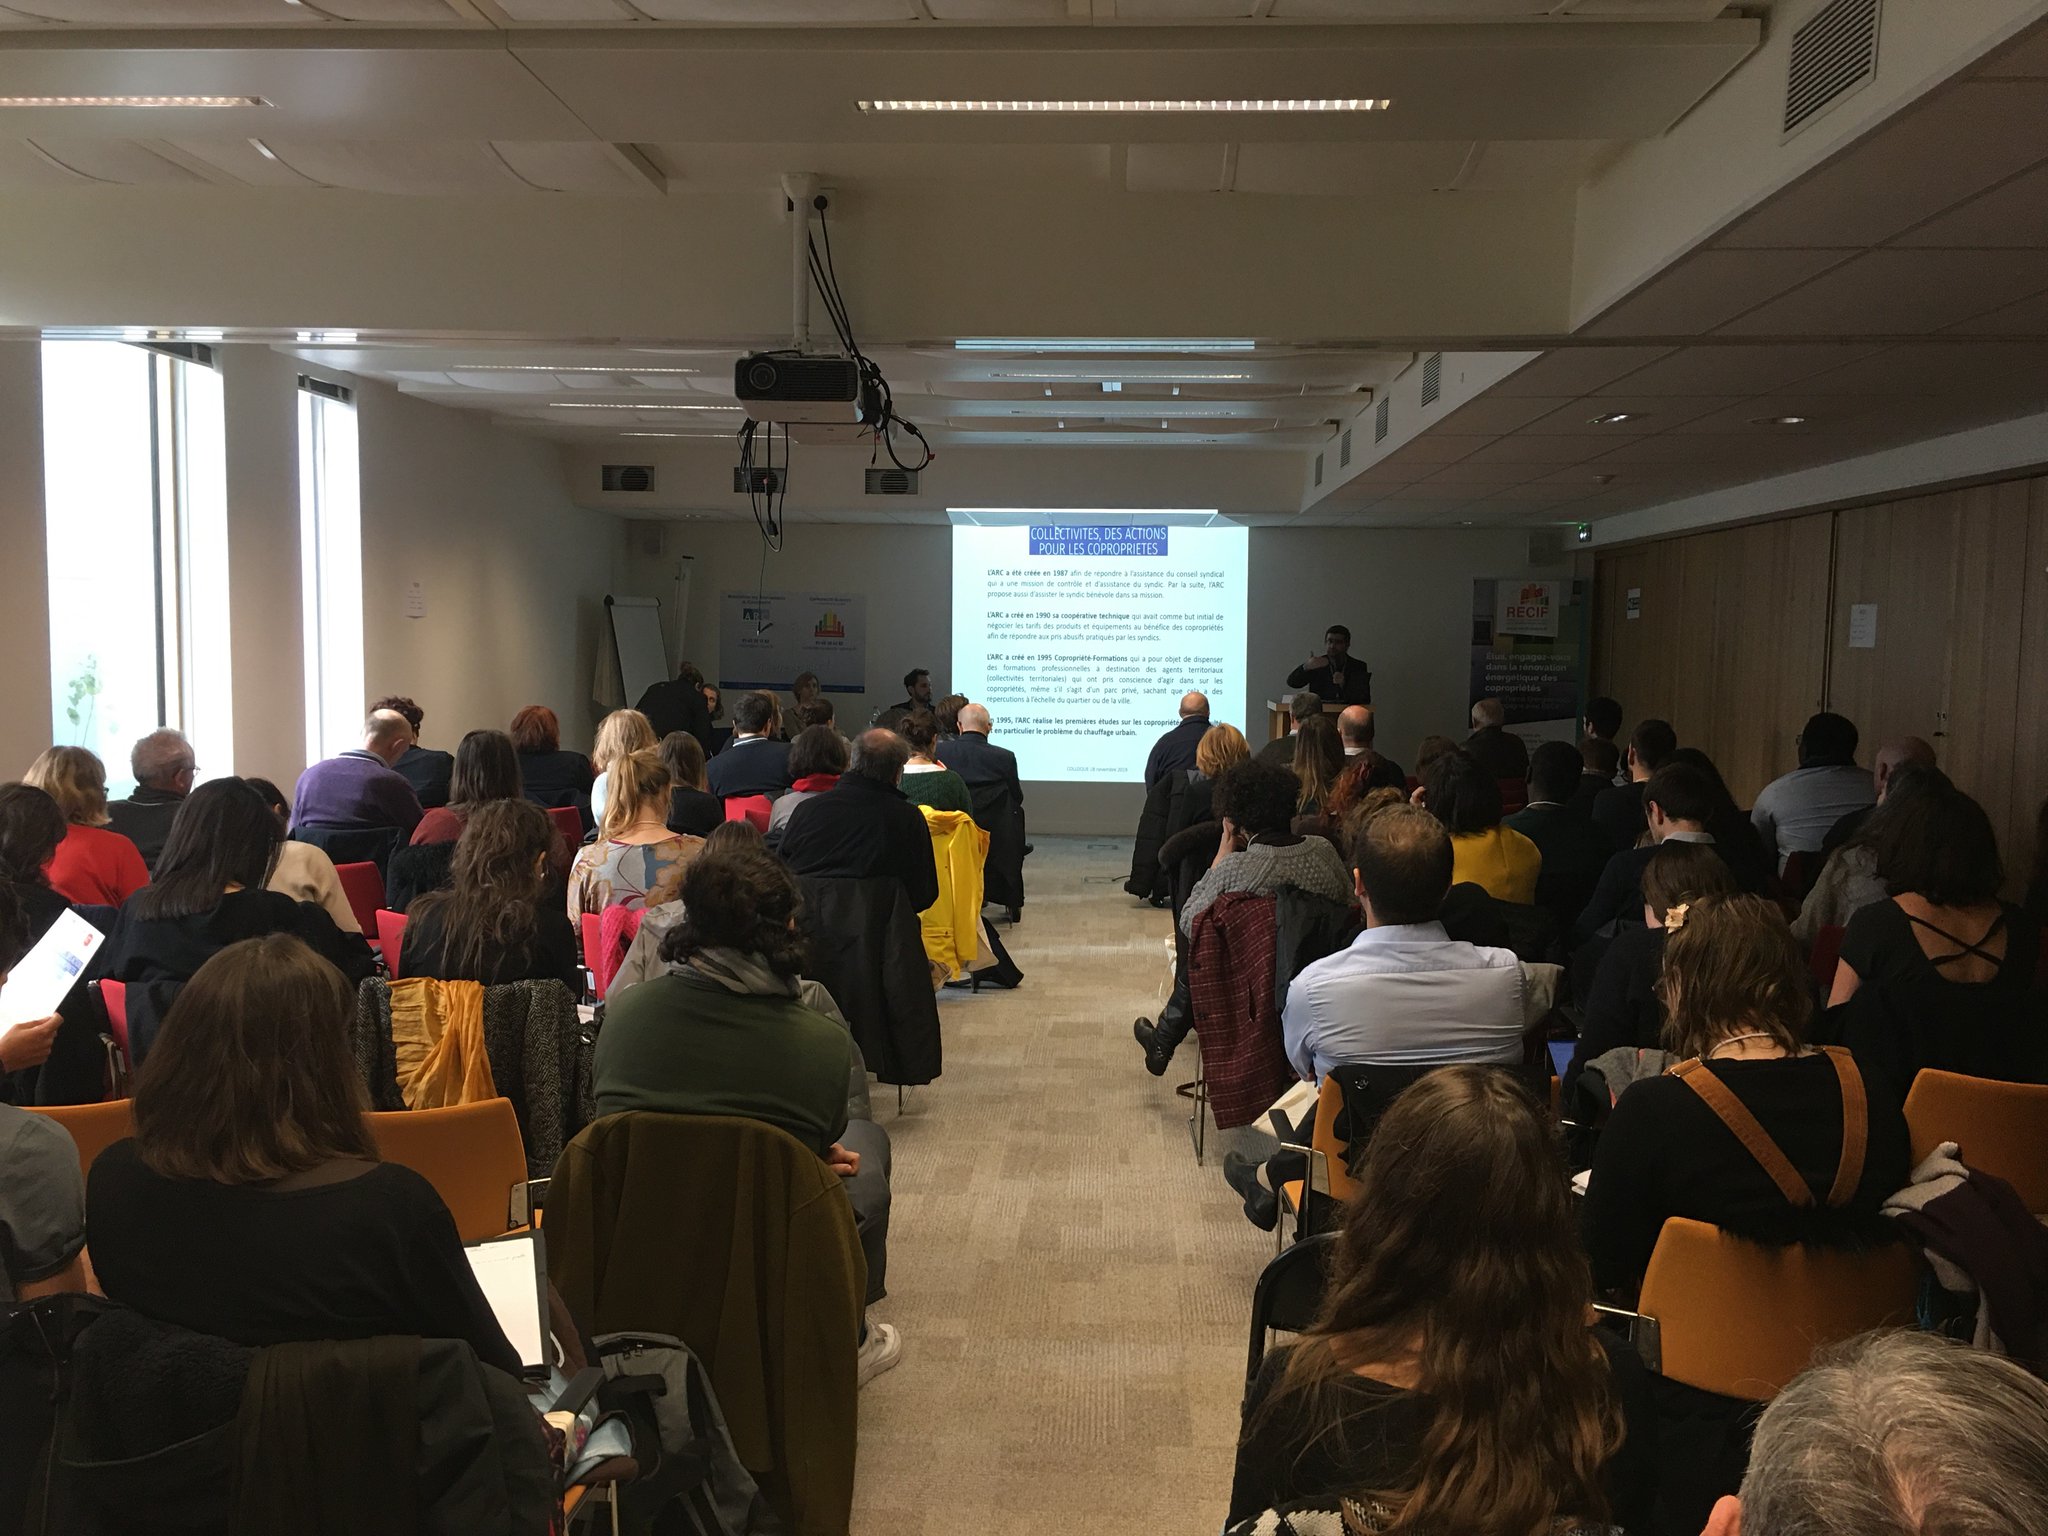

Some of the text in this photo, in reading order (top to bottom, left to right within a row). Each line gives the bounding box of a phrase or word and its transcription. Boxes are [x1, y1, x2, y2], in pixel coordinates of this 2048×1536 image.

[1031, 527, 1166, 542] COLLECTIVITES, DES ACTIONS
[1039, 542, 1159, 555] POUR LES COPROPRIETES
[1094, 569, 1122, 579] répondre
[1200, 569, 1225, 580] syndical
[987, 579, 998, 589] qui
[987, 592, 1013, 600] propose
[1066, 590, 1085, 600] syndic
[1060, 611, 1098, 621] coopérative
[1098, 611, 1130, 621] technique
[1131, 612, 1142, 622] qui
[987, 621, 1014, 631] négocier
[1056, 622, 1082, 632] produits
[1091, 622, 1132, 632] équipements
[1184, 622, 1224, 633] copropriétés
[1009, 632, 1038, 642] répondre
[1085, 632, 1115, 642] pratiqués
[1115, 634, 1126, 642] par
[1054, 653, 1128, 663] Copropriété-Formations
[1130, 654, 1140, 664] qui
[1148, 656, 1163, 664] pour
[1165, 654, 1181, 664] objet
[1193, 654, 1223, 664] dispenser
[1042, 664, 1091, 674] professionnelles
[1162, 665, 1183, 675] agents
[1486, 663, 1567, 672] dans la rénovation
[987, 674, 1024, 684] (collectivités
[1029, 674, 1067, 684] territoriales)
[1072, 675, 1082, 685] qui
[1157, 675, 1174, 685] d'agir
[1485, 674, 1539, 682] énergétique
[1066, 685, 1082, 695] s'agit
[1104, 687, 1118, 695] parc
[1171, 688, 1183, 696] que
[1484, 684, 1542, 693] copropriétés
[986, 695, 1025, 705] répercutions
[1066, 696, 1091, 706] quartier
[1065, 716, 1097, 726] premières
[1144, 717, 1180, 727] copropriété
[1003, 726, 1035, 736] particulier
[1043, 727, 1073, 737] problème
[1084, 727, 1114, 737] chauffage
